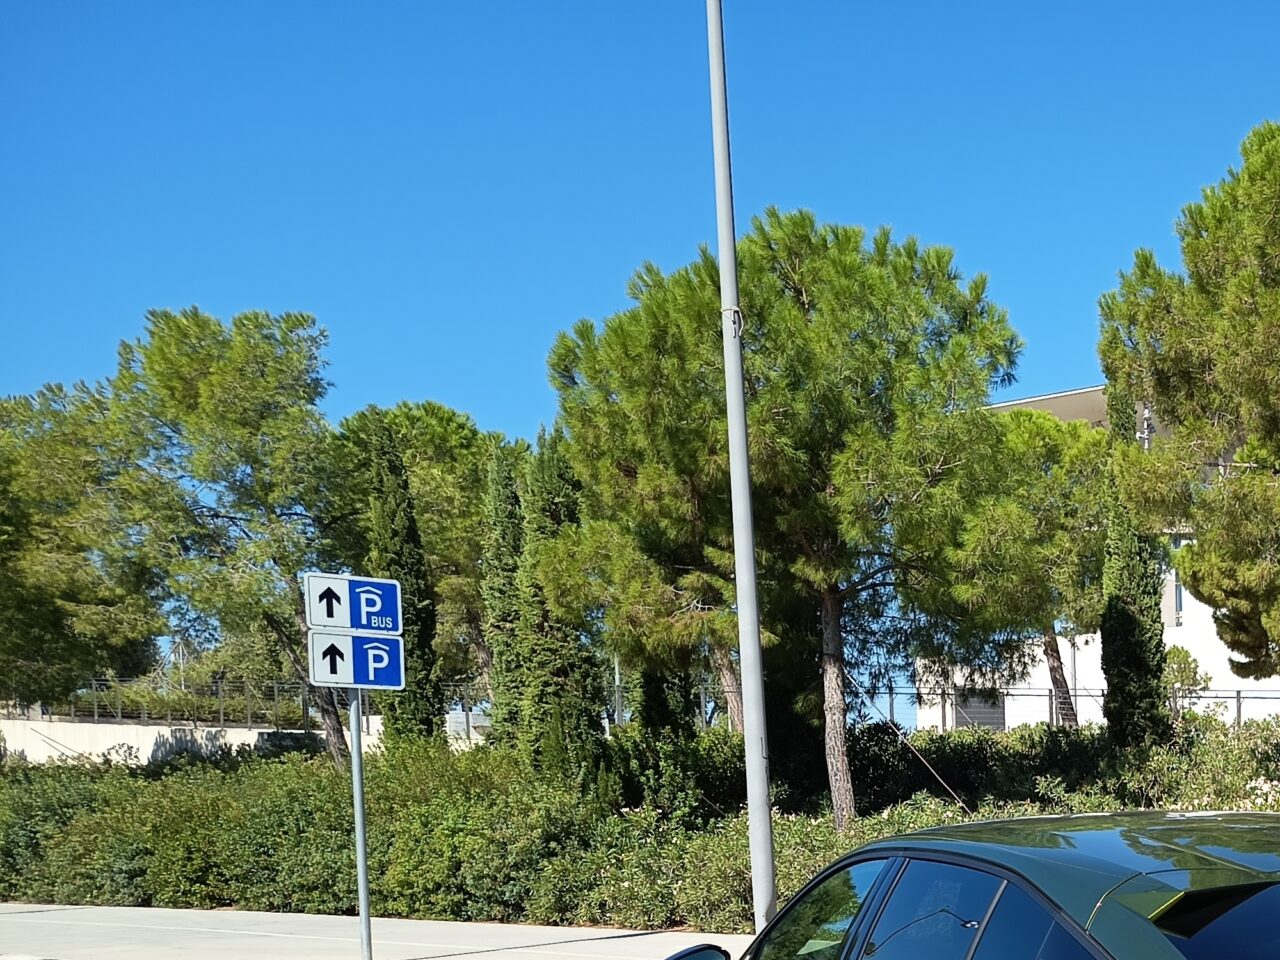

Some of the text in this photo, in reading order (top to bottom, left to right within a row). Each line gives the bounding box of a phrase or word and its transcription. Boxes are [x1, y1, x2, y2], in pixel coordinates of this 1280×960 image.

[360, 592, 382, 625] P
[371, 616, 393, 628] BUS
[367, 649, 389, 681] P
